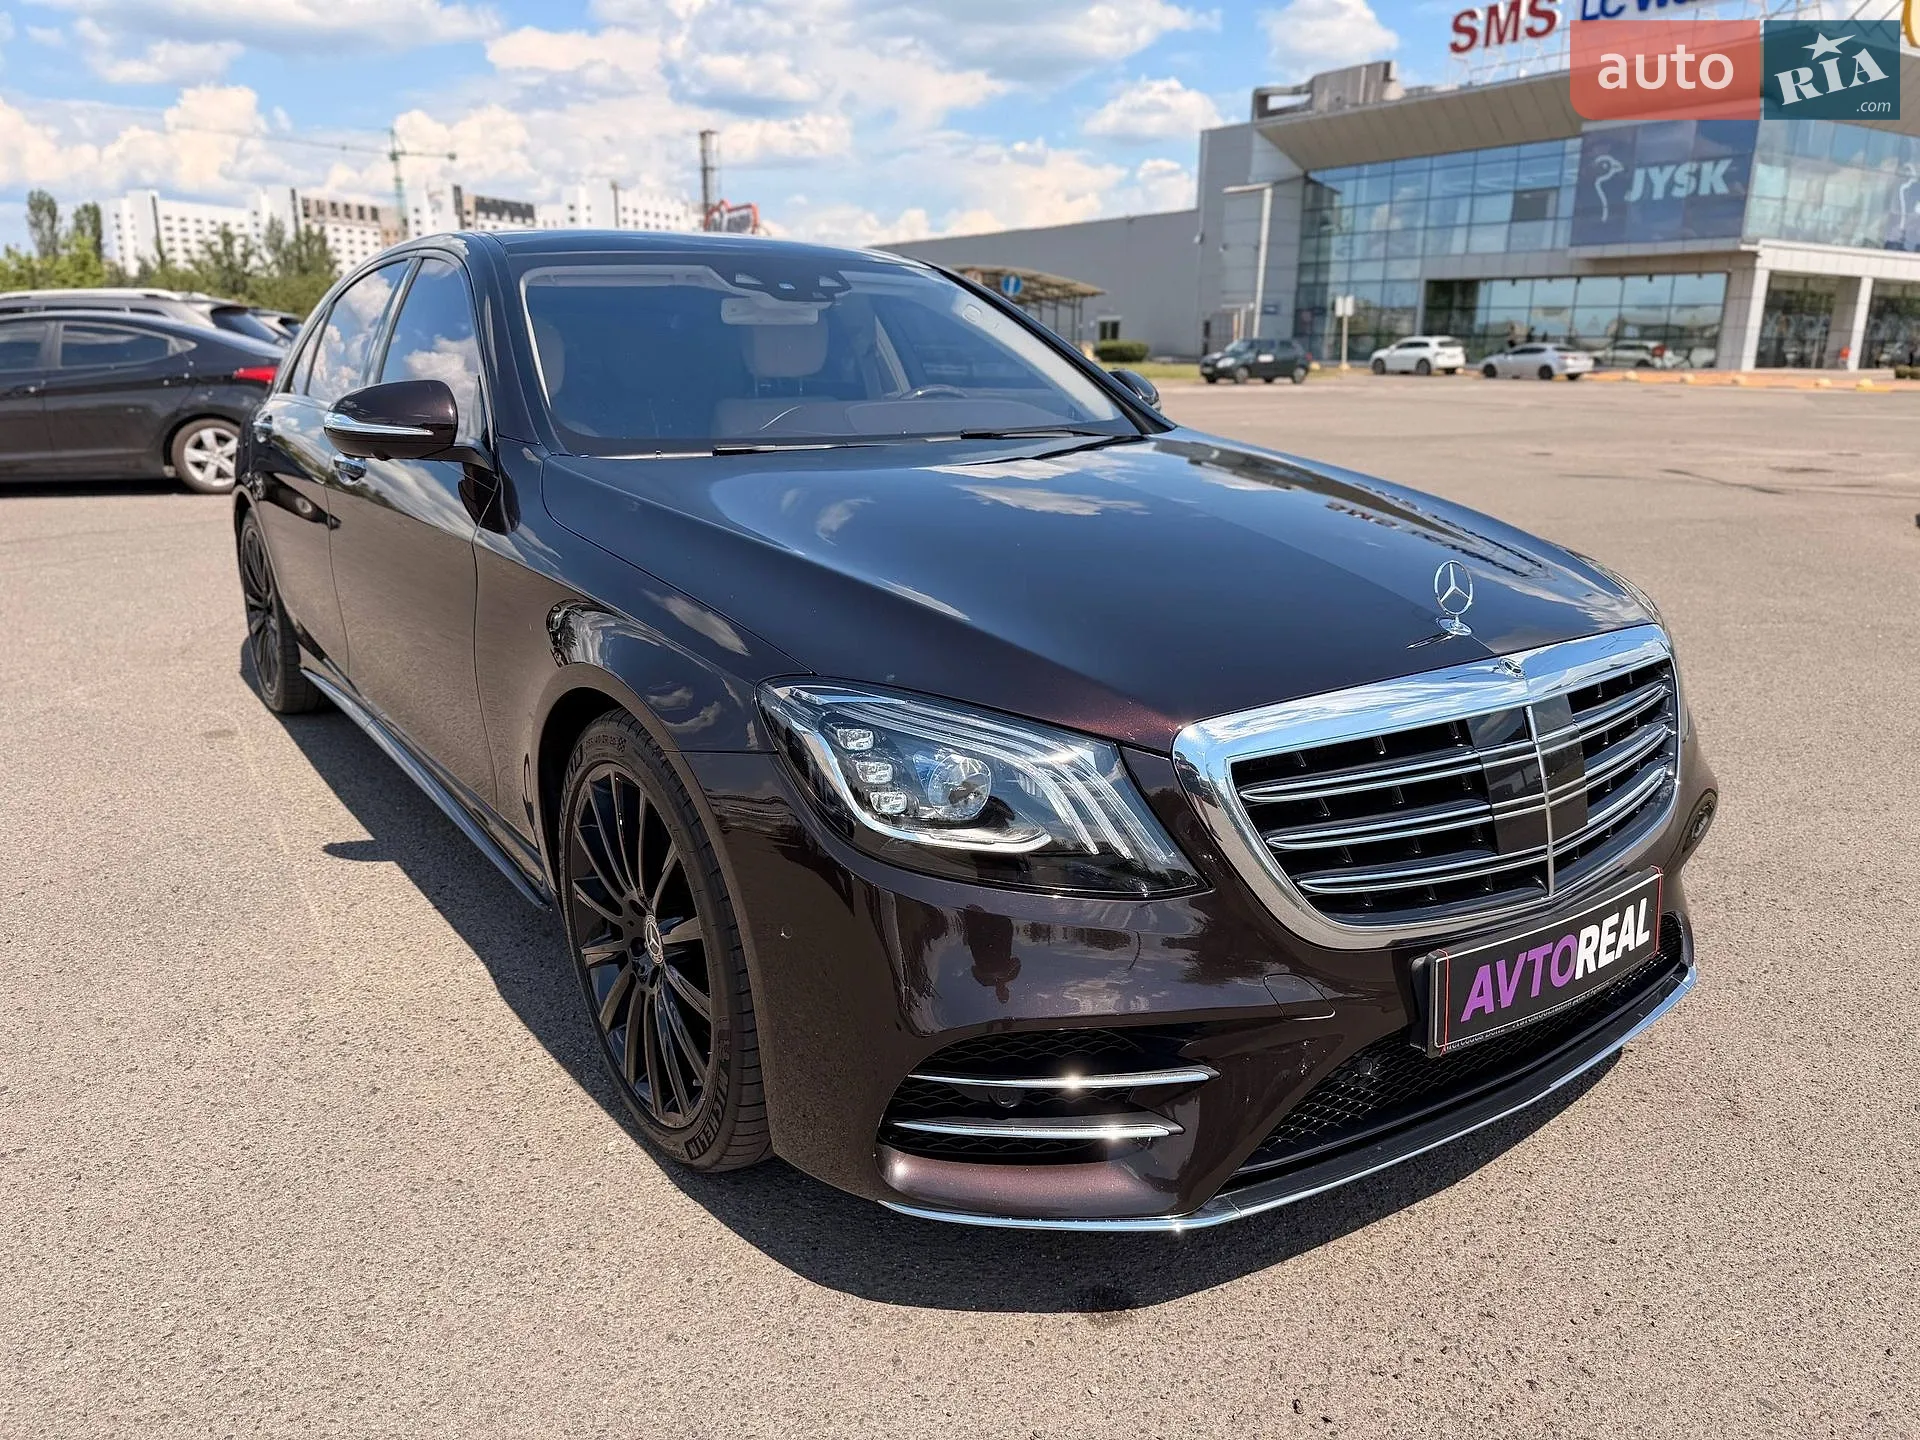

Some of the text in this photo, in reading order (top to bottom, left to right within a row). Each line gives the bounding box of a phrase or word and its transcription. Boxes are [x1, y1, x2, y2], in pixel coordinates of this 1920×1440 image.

[1449, 0, 1557, 53] SMS
[1624, 158, 1733, 202] JYSK
[1460, 898, 1650, 1022] AVTOREAL
